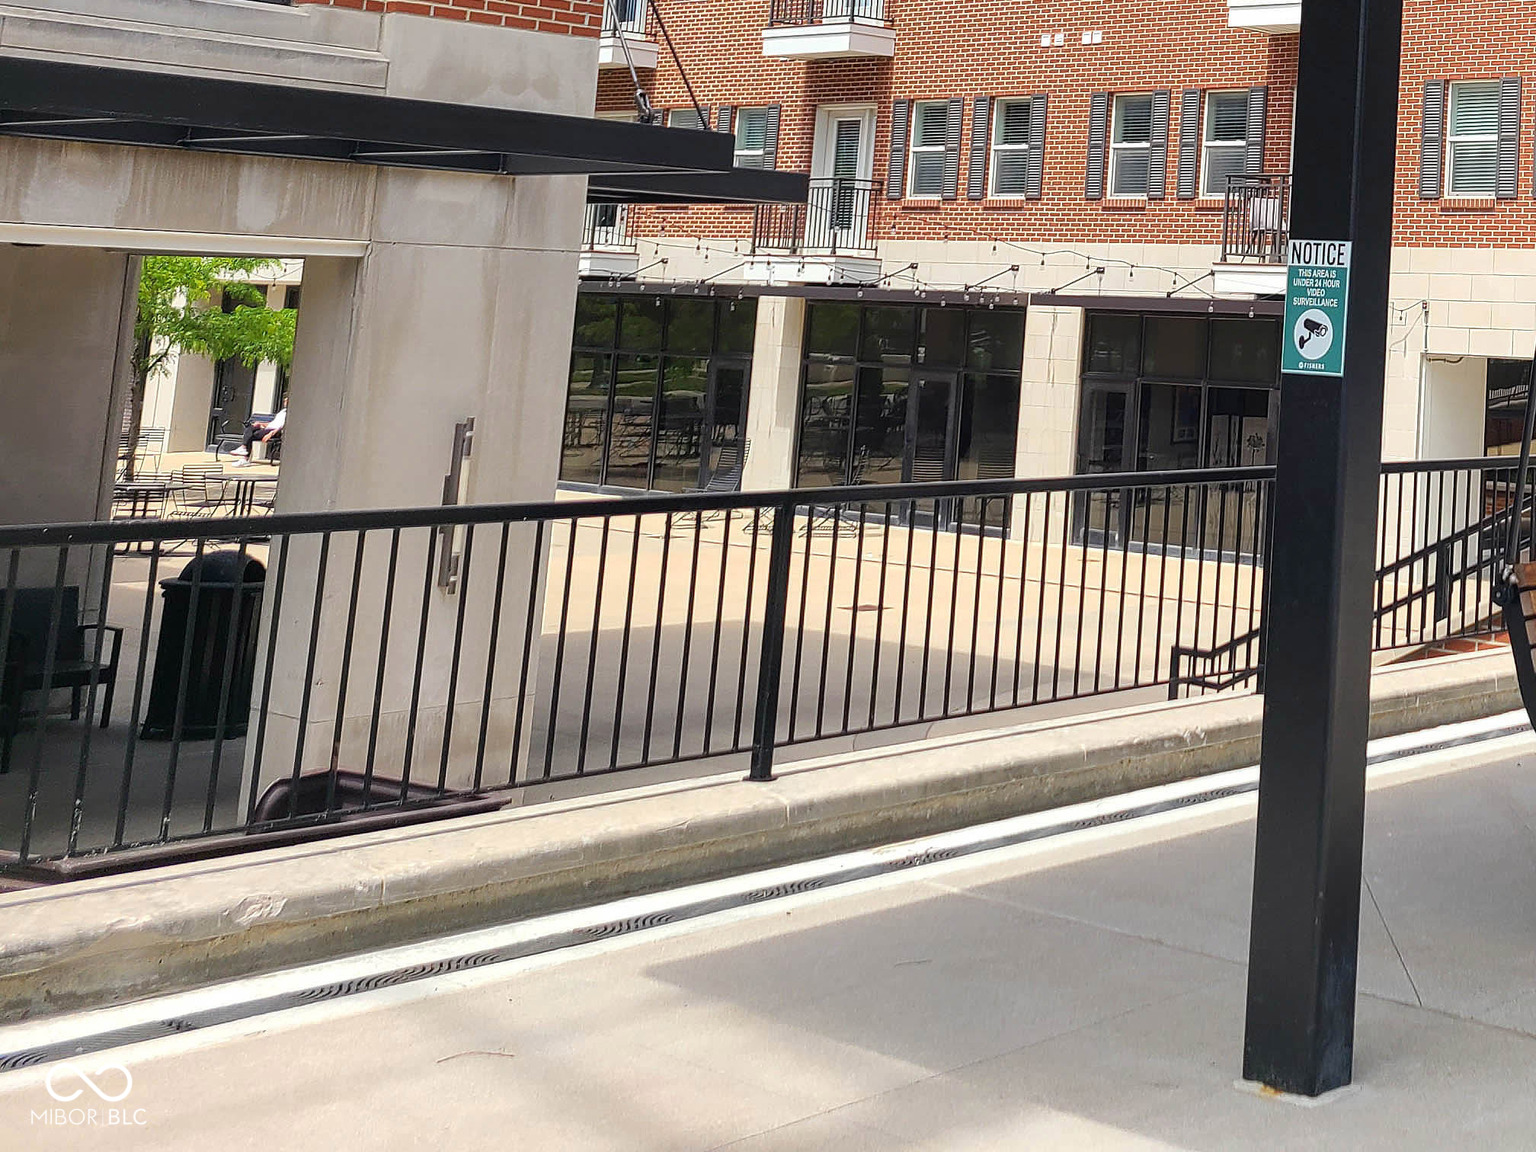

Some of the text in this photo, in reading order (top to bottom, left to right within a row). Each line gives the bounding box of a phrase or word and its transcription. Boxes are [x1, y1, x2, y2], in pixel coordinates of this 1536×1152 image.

[1291, 241, 1346, 266] NOTICE
[1298, 269, 1336, 278] THIS AREA IS
[1293, 278, 1340, 288] UNDER 24 HOUR
[1306, 288, 1326, 297] VIDEO
[1292, 297, 1338, 307] SURVEILLANCE
